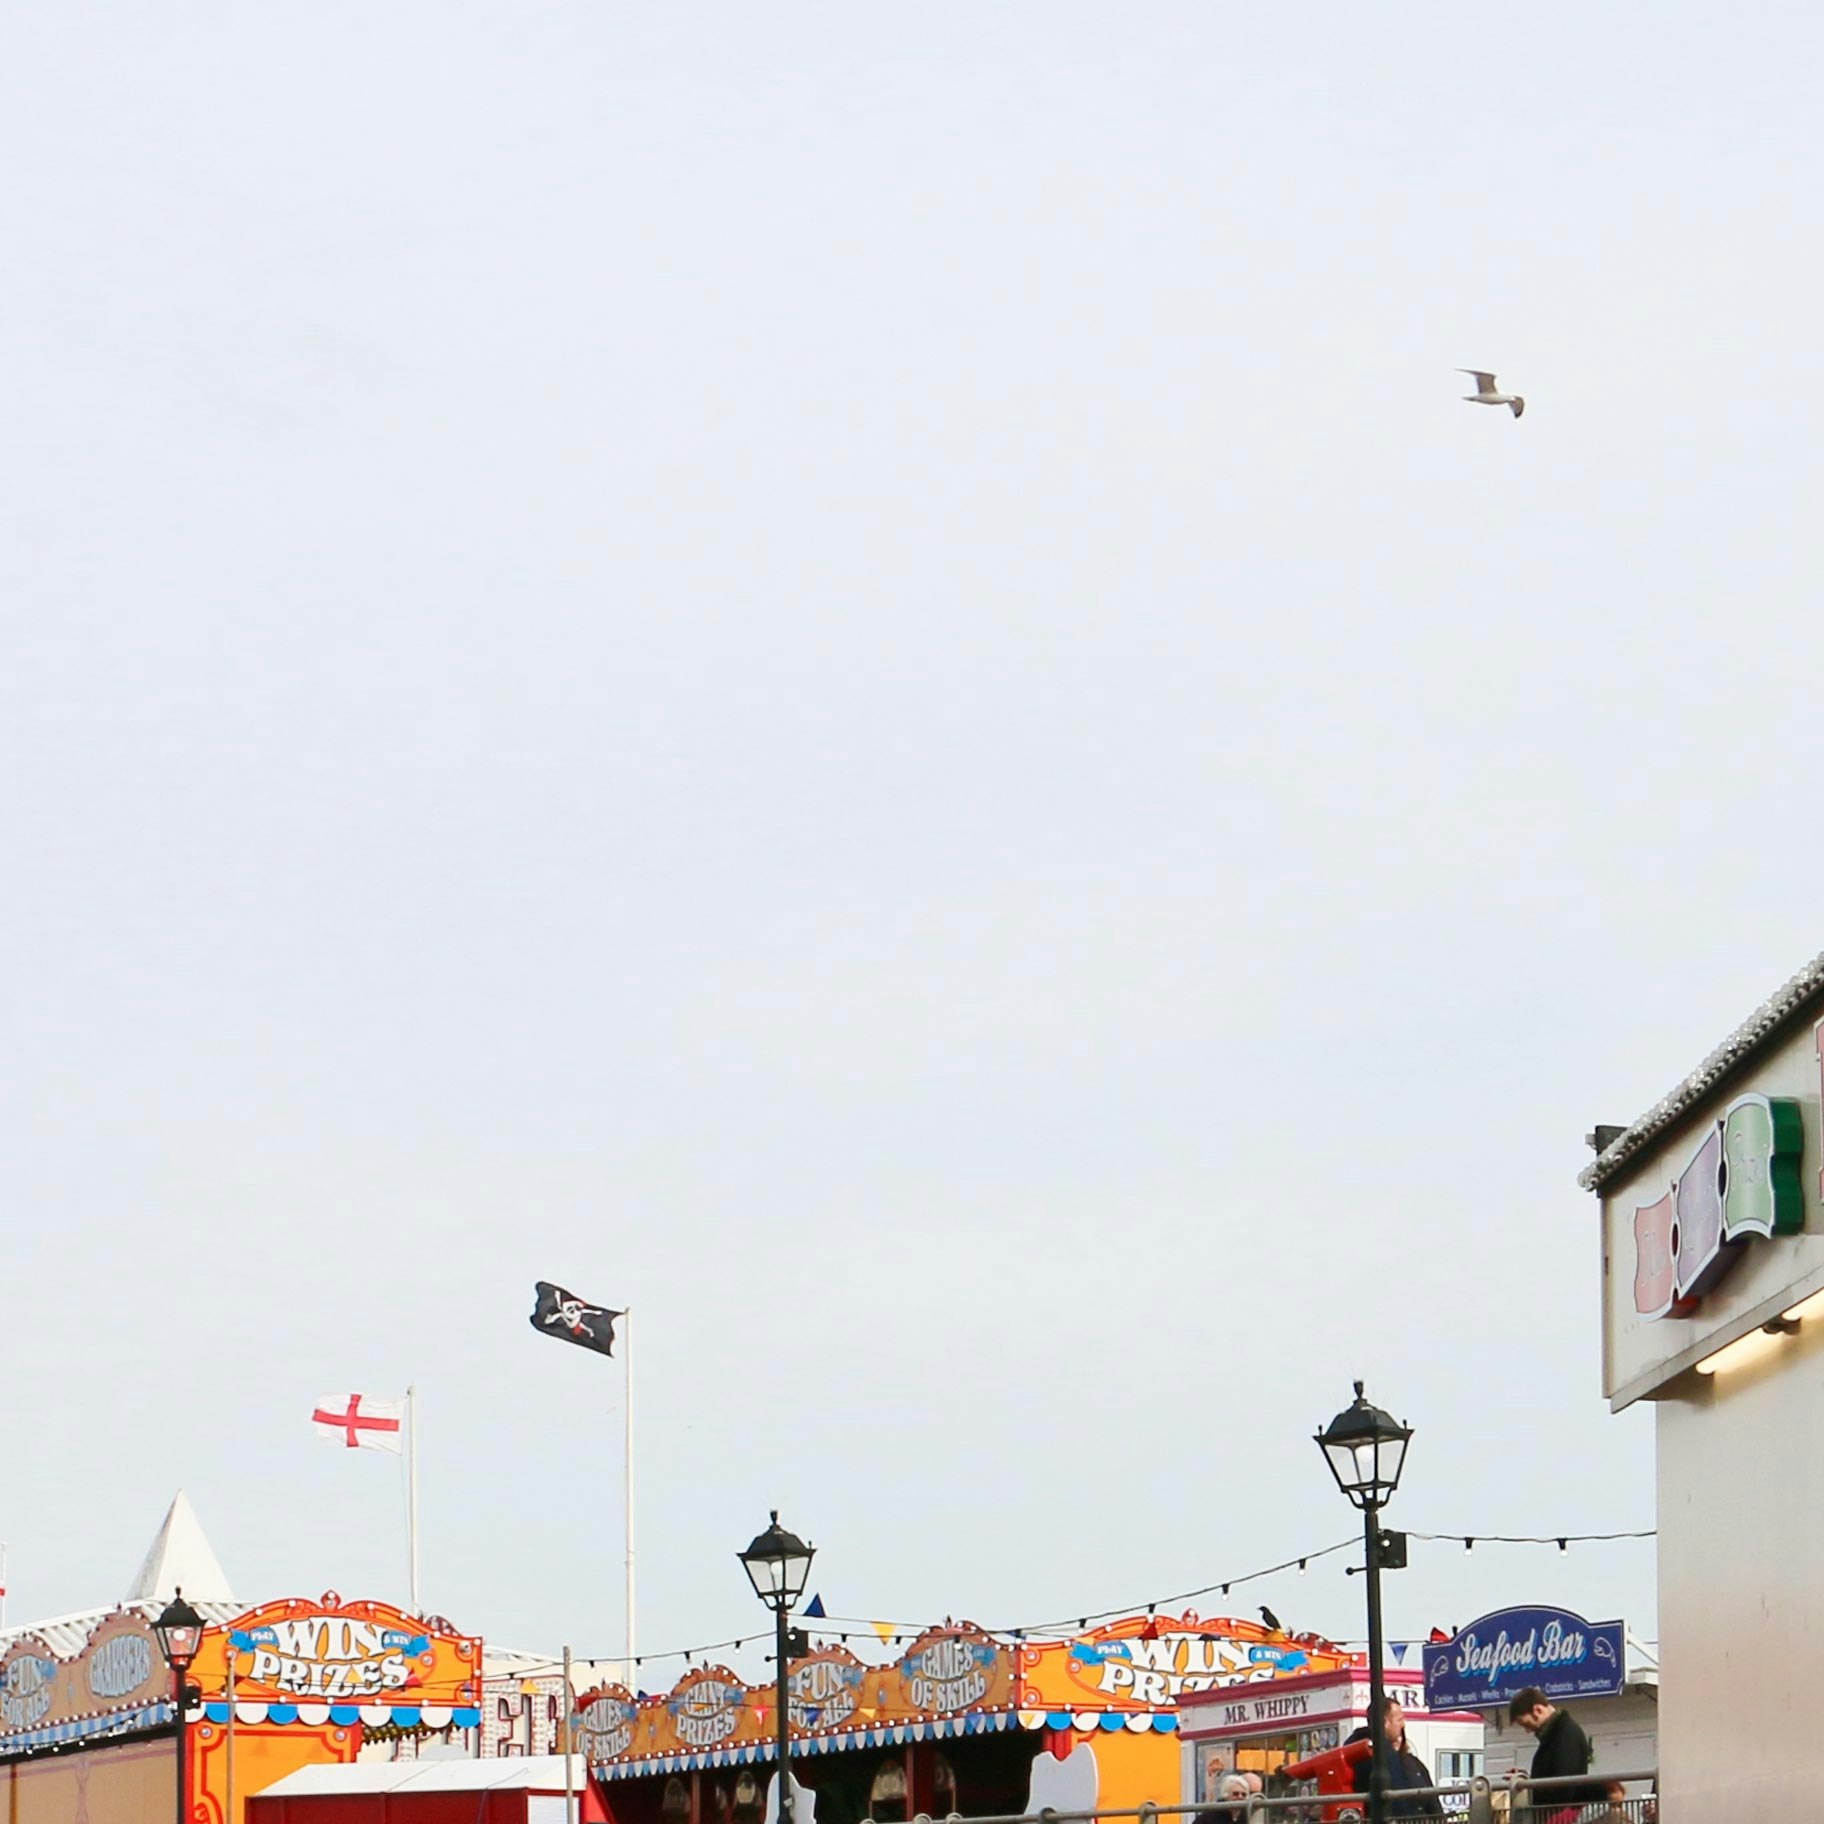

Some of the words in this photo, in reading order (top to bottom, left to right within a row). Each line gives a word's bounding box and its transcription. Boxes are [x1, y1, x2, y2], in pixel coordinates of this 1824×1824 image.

[268, 1615, 390, 1661] WIN
[921, 1637, 975, 1680] GAMES
[1121, 1632, 1256, 1674] WIN
[1455, 1629, 1536, 1683] Seafood
[1538, 1619, 1586, 1664] Bar
[6, 1655, 45, 1697] FUN
[249, 1647, 410, 1698] PRIZES
[794, 1661, 845, 1701] FUN
[911, 1677, 933, 1711] OF
[936, 1670, 987, 1713] SKILL
[583, 1698, 623, 1733] GAMES
[683, 1680, 728, 1717] GIANT
[788, 1694, 819, 1731] FO
[823, 1690, 855, 1729] ALL
[1224, 1704, 1252, 1726] MR.
[1254, 1695, 1310, 1720] WHIPPY
[676, 1709, 737, 1746] PRIZES
